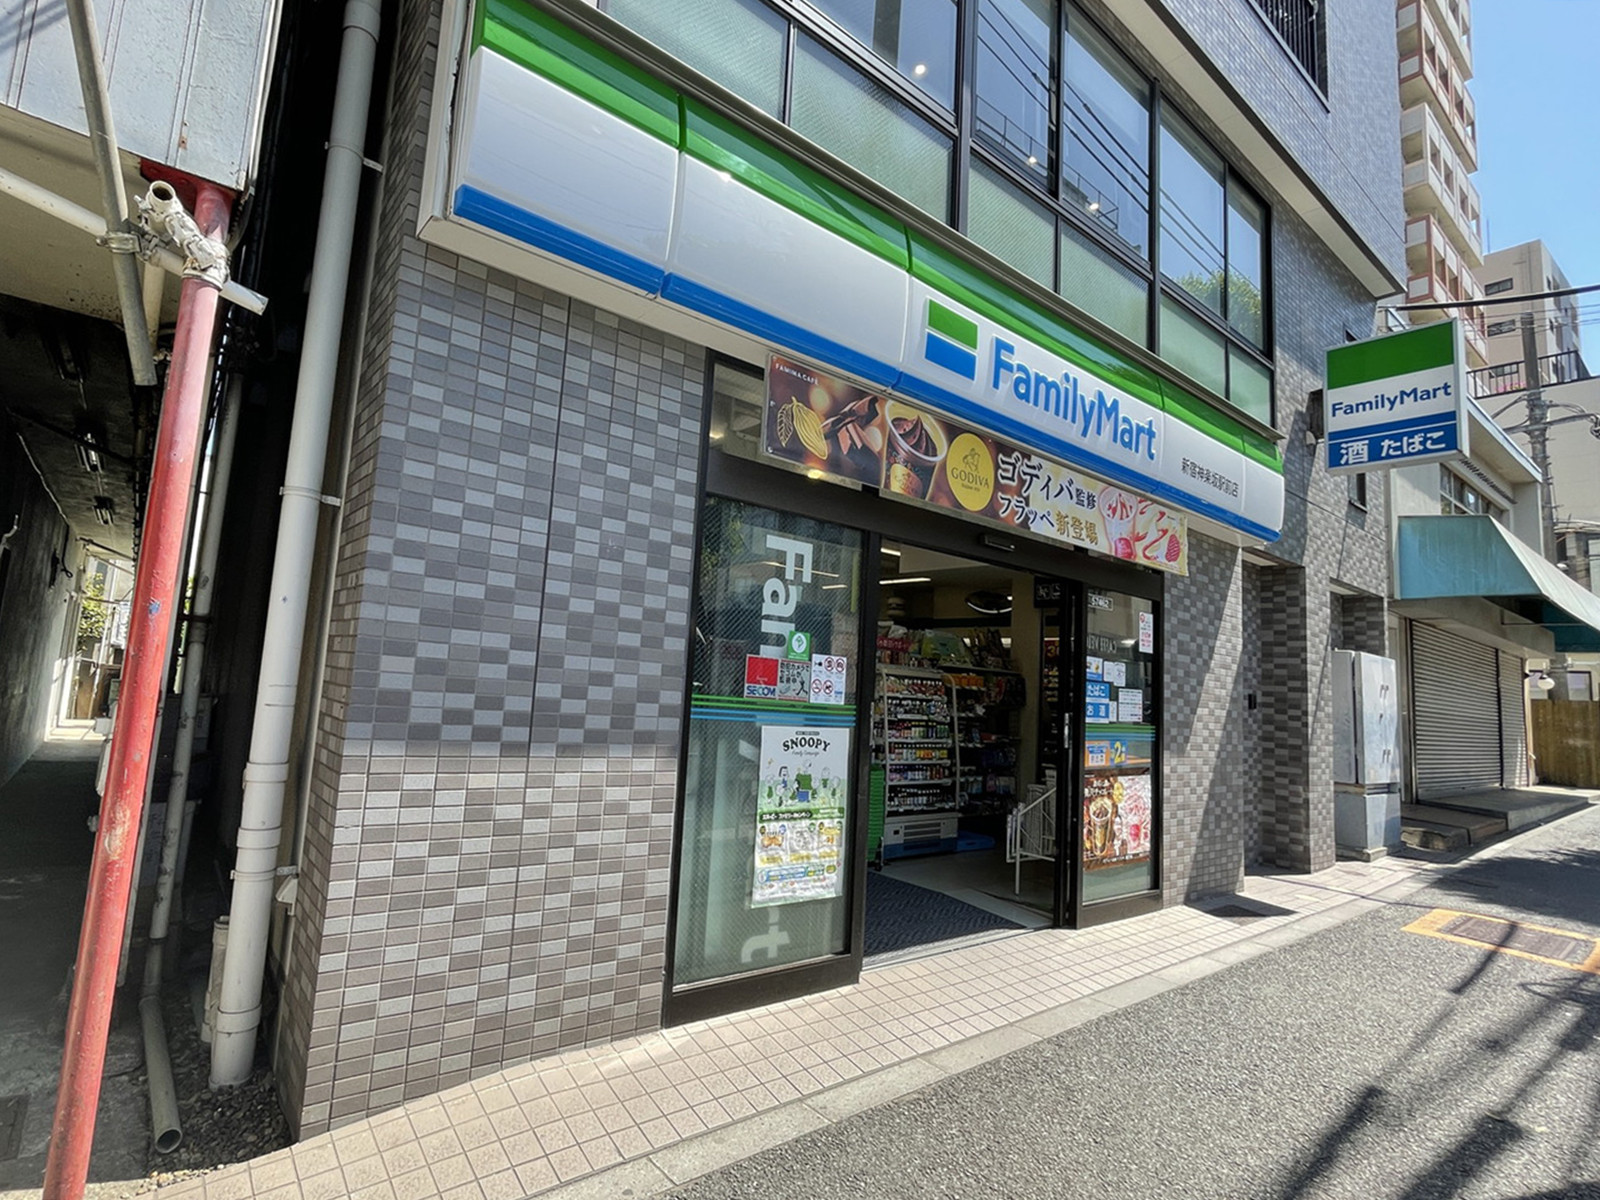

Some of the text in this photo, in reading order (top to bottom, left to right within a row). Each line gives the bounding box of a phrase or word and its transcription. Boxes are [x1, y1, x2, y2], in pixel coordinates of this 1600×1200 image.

[992, 335, 1156, 461] FamilyMart
[1331, 382, 1452, 418] FamilyMart
[1340, 431, 1446, 465] 酒 たばこ
[951, 467, 990, 488] GODIVA
[746, 685, 776, 697] SECOM
[782, 737, 831, 752] SNOOPY
